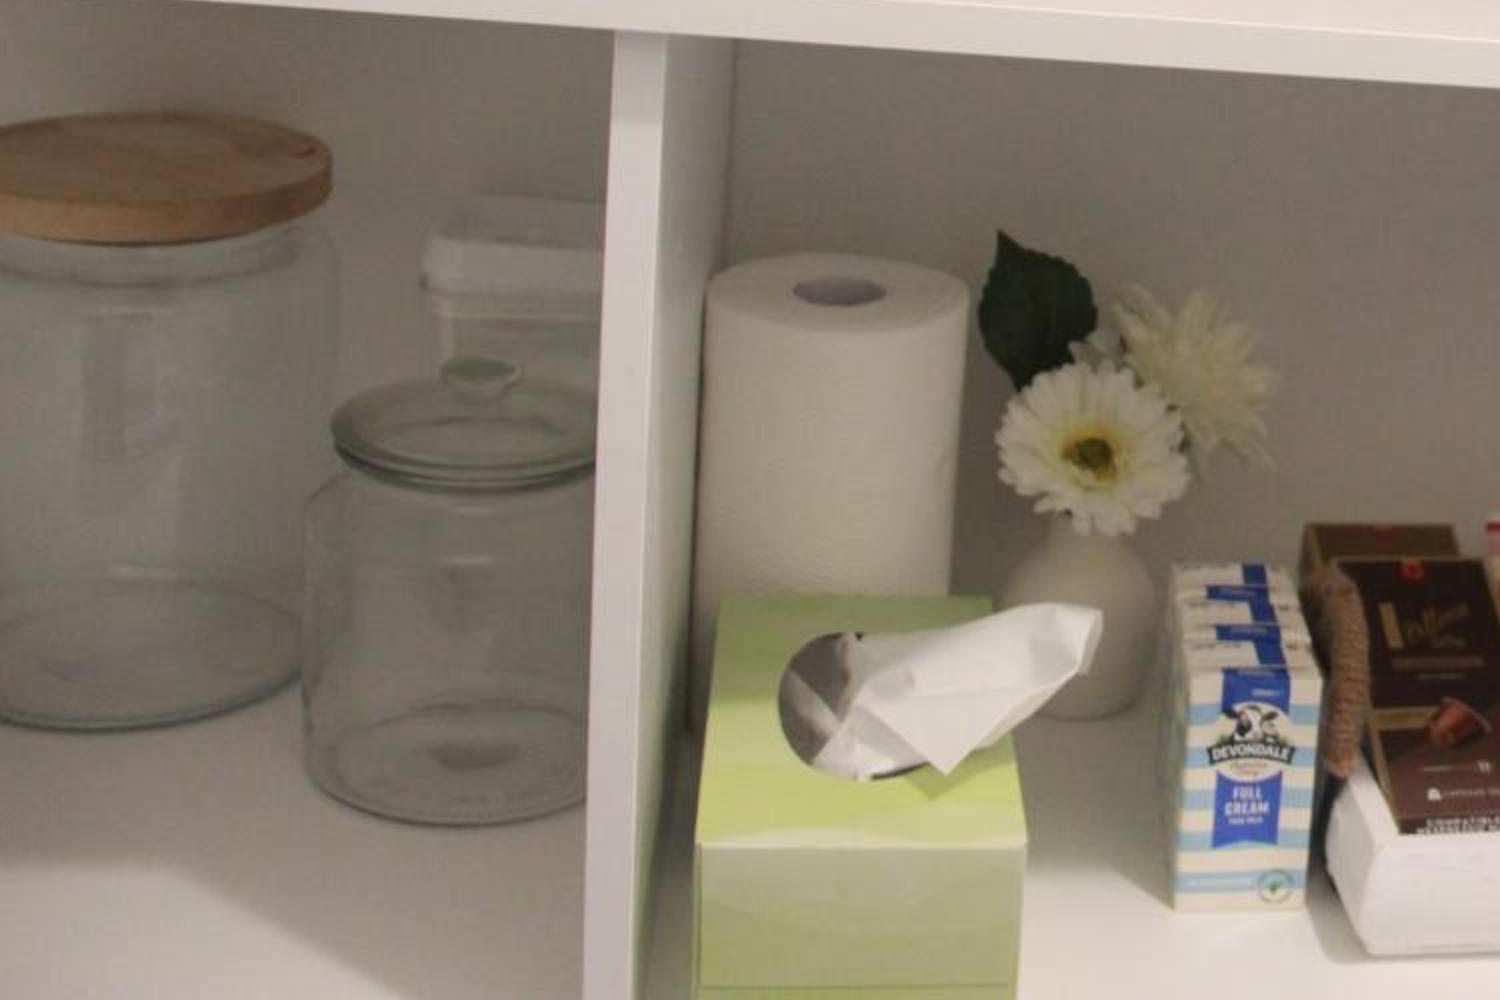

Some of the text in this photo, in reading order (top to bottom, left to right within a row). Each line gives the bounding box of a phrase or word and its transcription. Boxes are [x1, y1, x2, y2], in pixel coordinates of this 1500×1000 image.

[1211, 743, 1290, 763] DEVONDALE
[1232, 785, 1264, 801] FULL
[1224, 801, 1270, 818] CREAM
